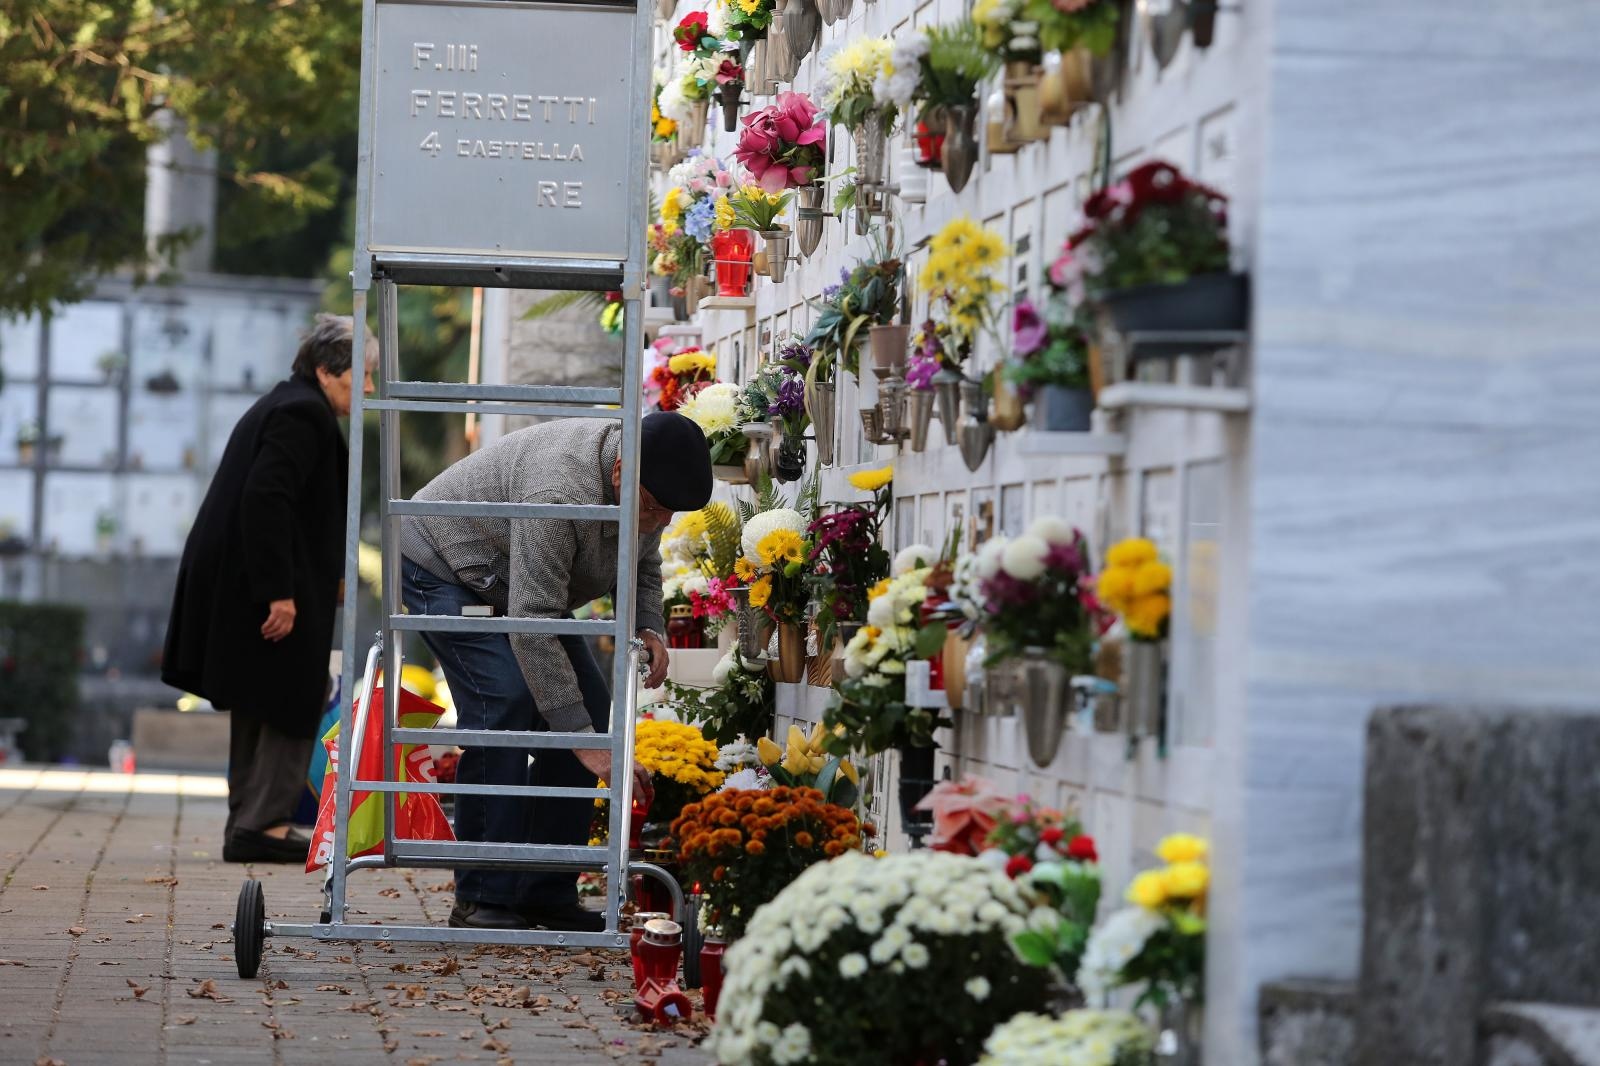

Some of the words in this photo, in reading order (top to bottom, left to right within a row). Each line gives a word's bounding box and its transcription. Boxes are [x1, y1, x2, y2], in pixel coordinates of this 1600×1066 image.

[411, 90, 596, 124] FERRETTI
[420, 131, 441, 157] 4
[457, 139, 583, 161] CASTELLA
[537, 181, 583, 208] RE
